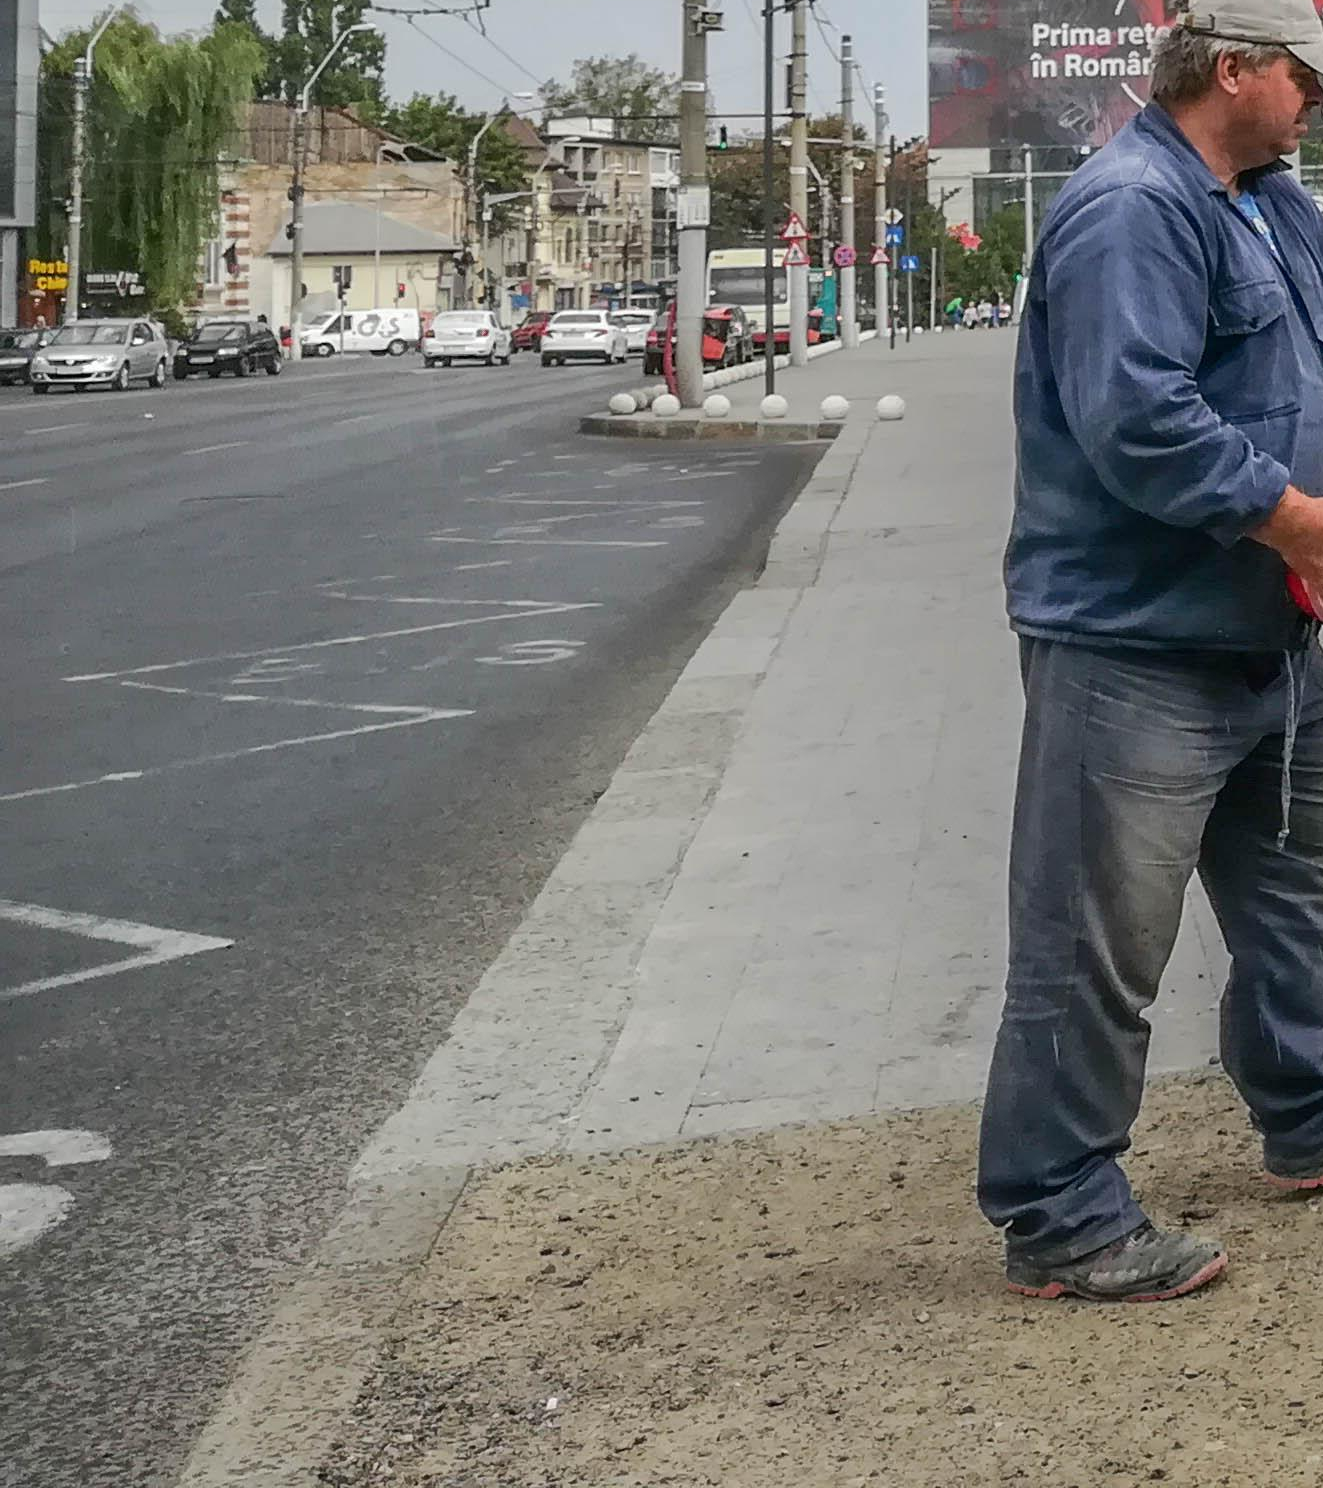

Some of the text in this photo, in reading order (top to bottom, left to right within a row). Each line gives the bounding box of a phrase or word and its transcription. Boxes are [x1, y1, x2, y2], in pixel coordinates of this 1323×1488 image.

[1032, 23, 1112, 47] Prima
[1030, 50, 1152, 78] în Român
